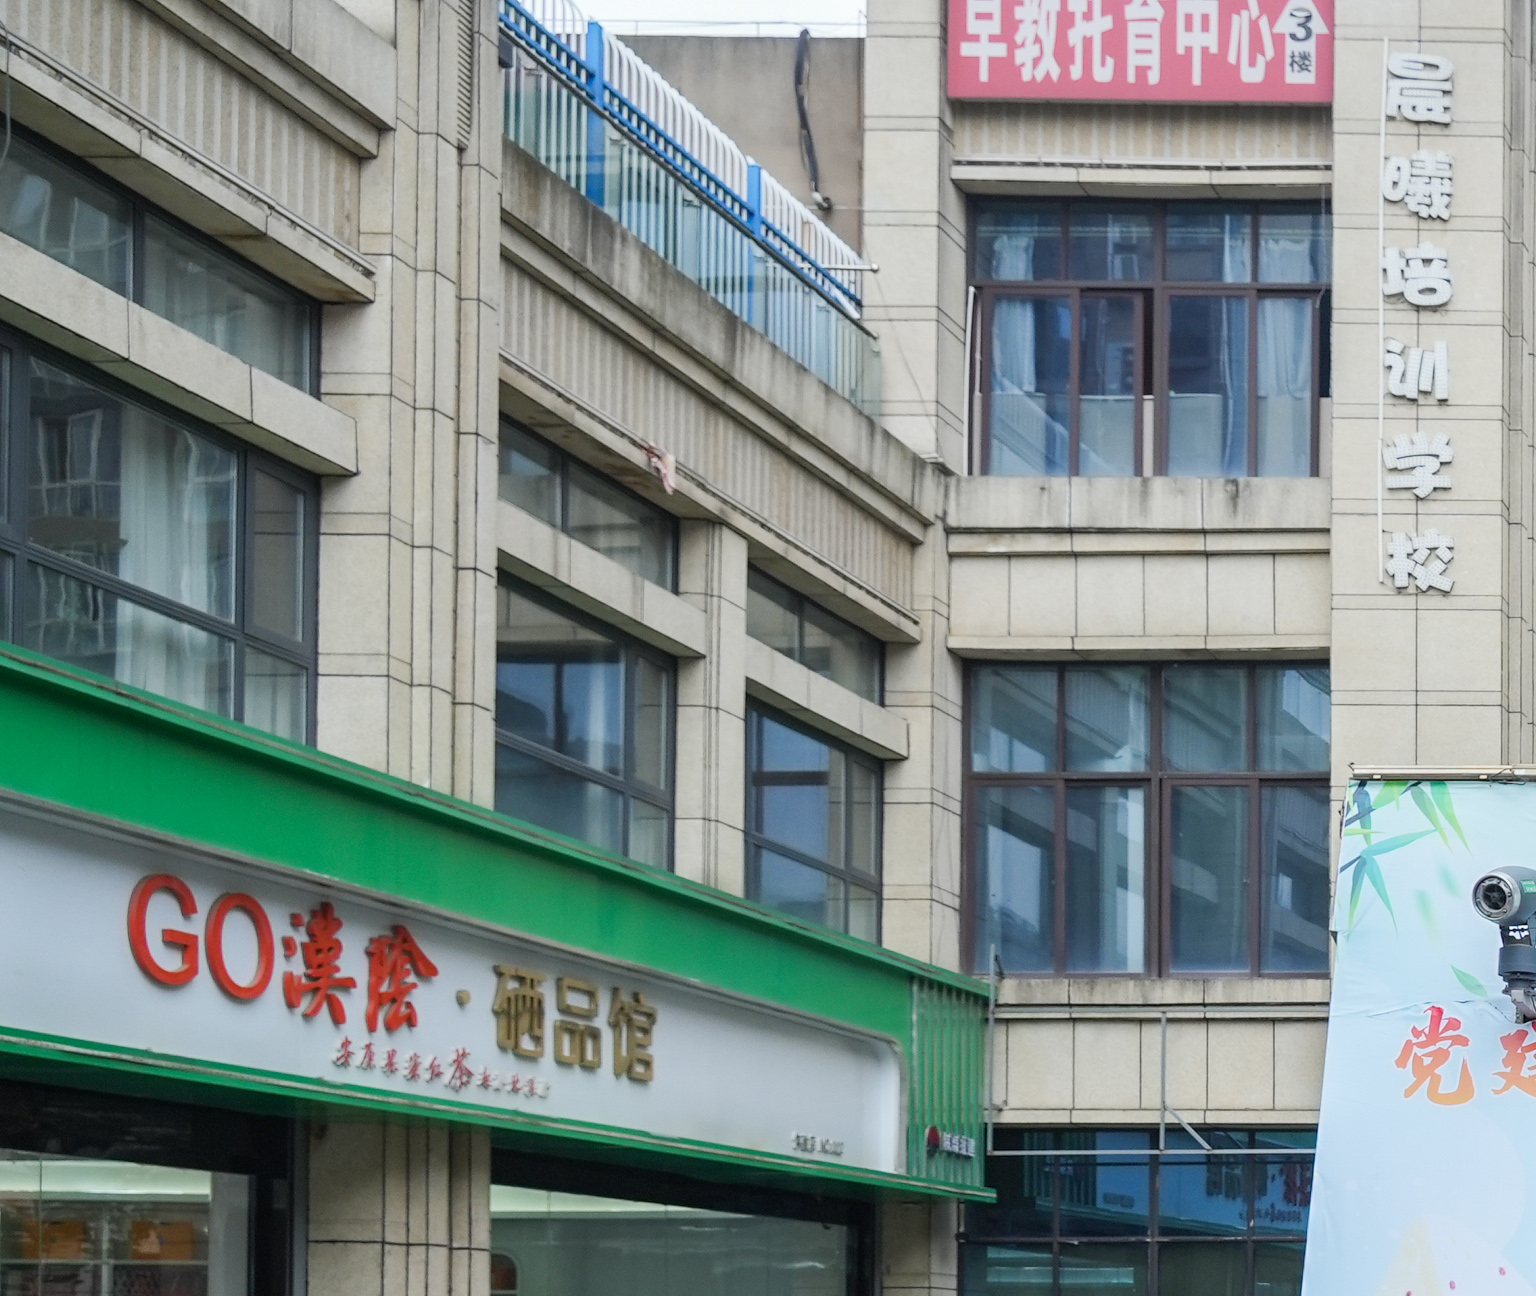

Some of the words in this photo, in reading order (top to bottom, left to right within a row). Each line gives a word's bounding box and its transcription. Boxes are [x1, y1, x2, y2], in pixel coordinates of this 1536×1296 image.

[960, 0, 1275, 86] 早教托育中心
[1382, 52, 1455, 593] 晨曦培训学校
